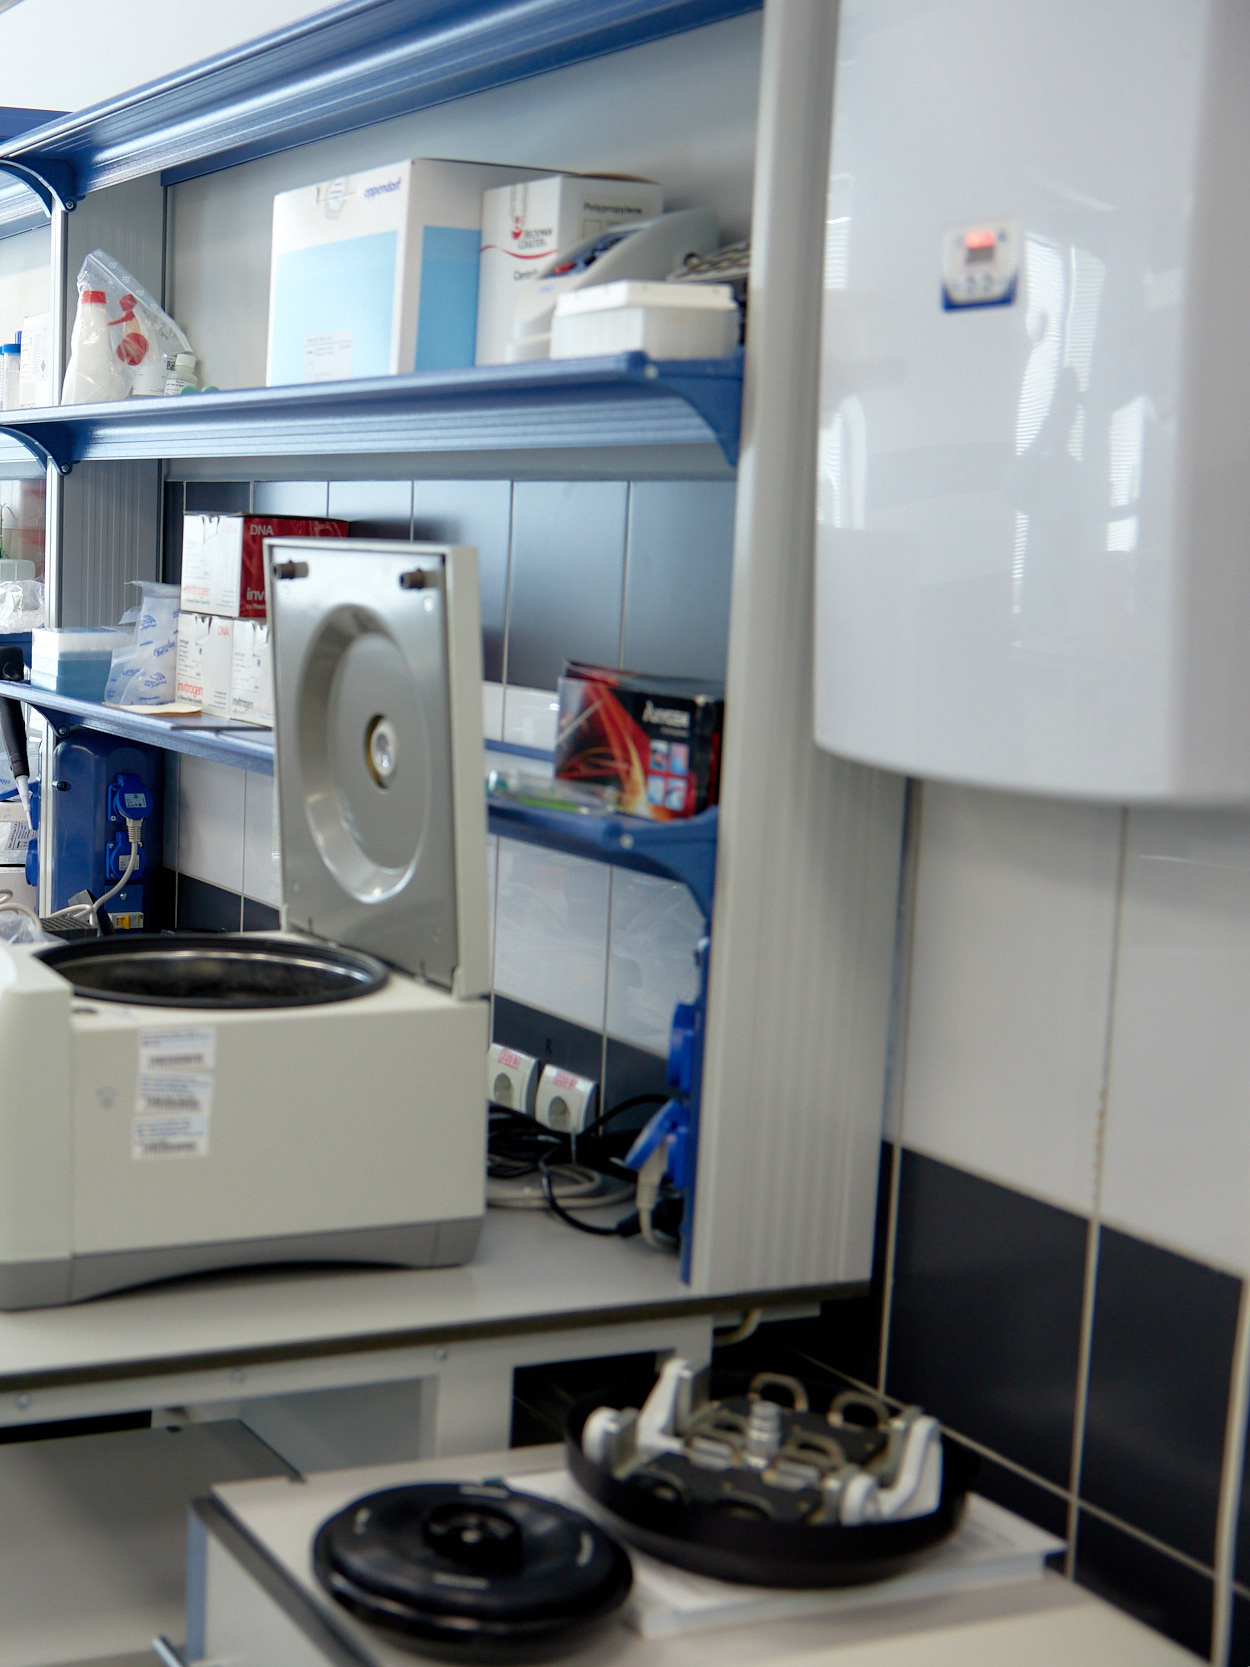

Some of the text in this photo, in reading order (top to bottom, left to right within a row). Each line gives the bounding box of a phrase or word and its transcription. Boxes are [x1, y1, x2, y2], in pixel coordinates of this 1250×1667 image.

[583, 202, 642, 215] Polypropylene
[250, 524, 274, 536] DNA
[177, 680, 203, 698] invitrogen
